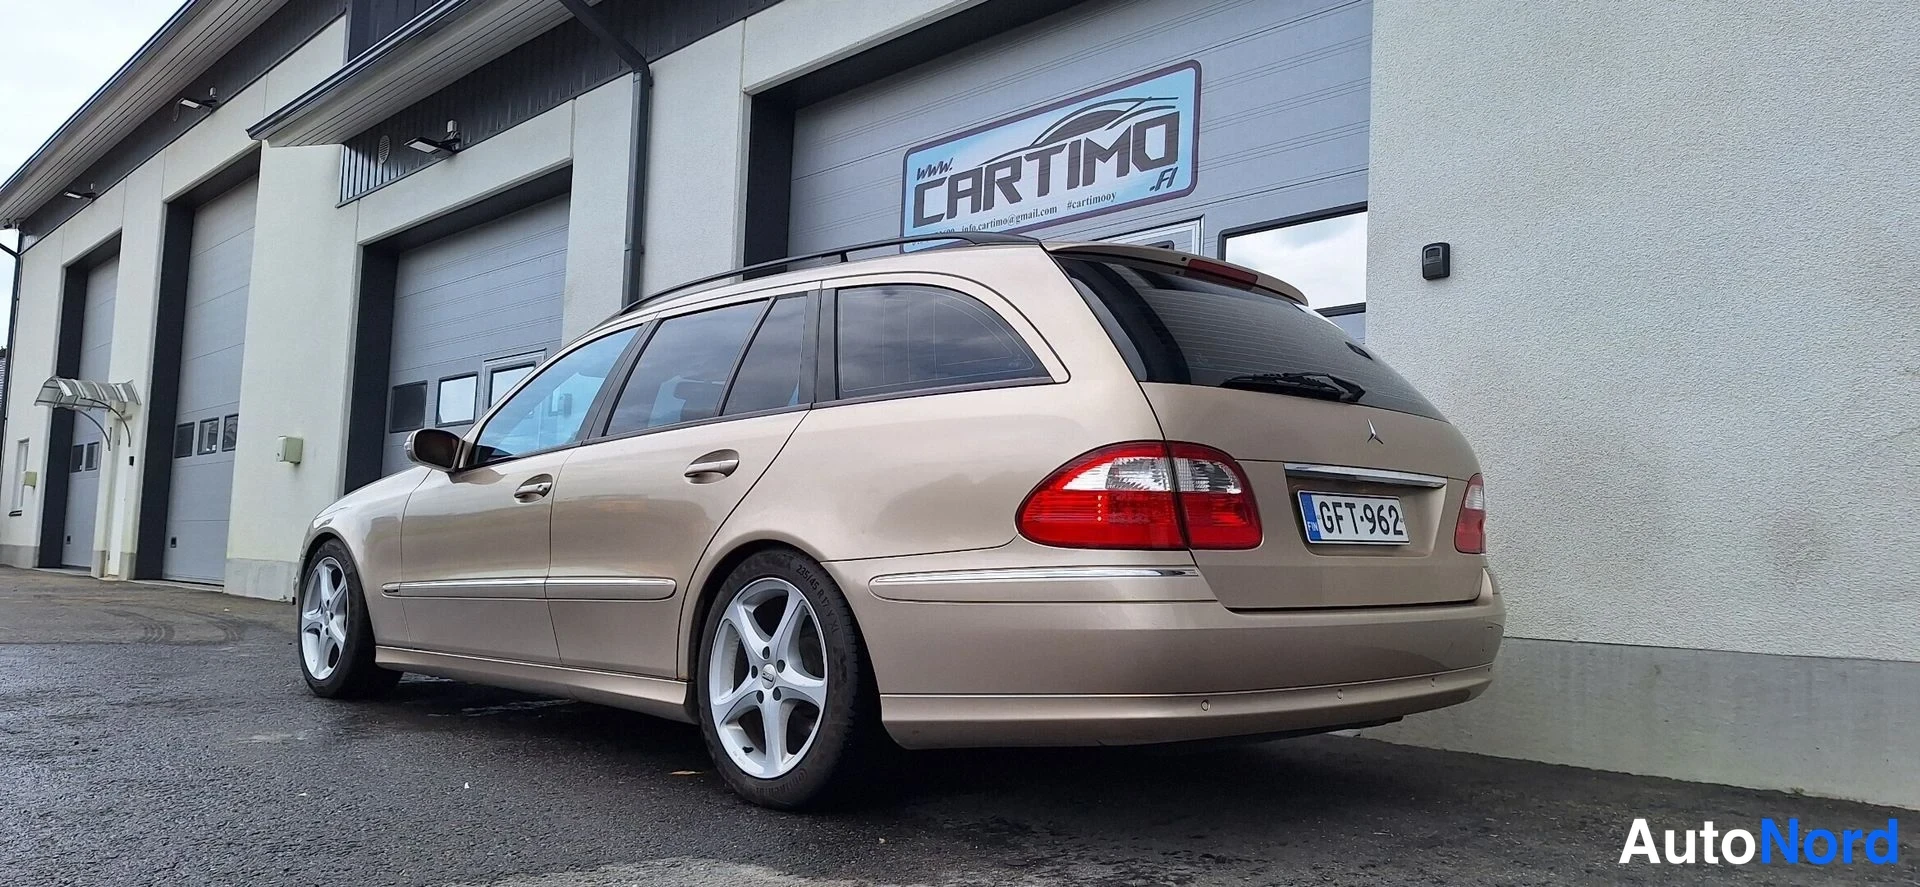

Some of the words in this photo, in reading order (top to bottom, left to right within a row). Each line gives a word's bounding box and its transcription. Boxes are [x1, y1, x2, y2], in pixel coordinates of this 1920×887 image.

[912, 111, 1180, 228] CARTIMO
[1066, 191, 1117, 211] #cartimooy
[1308, 521, 1319, 532] FIN
[1319, 501, 1404, 535] GFT-962
[796, 564, 820, 590] 235/45
[817, 588, 825, 599] R
